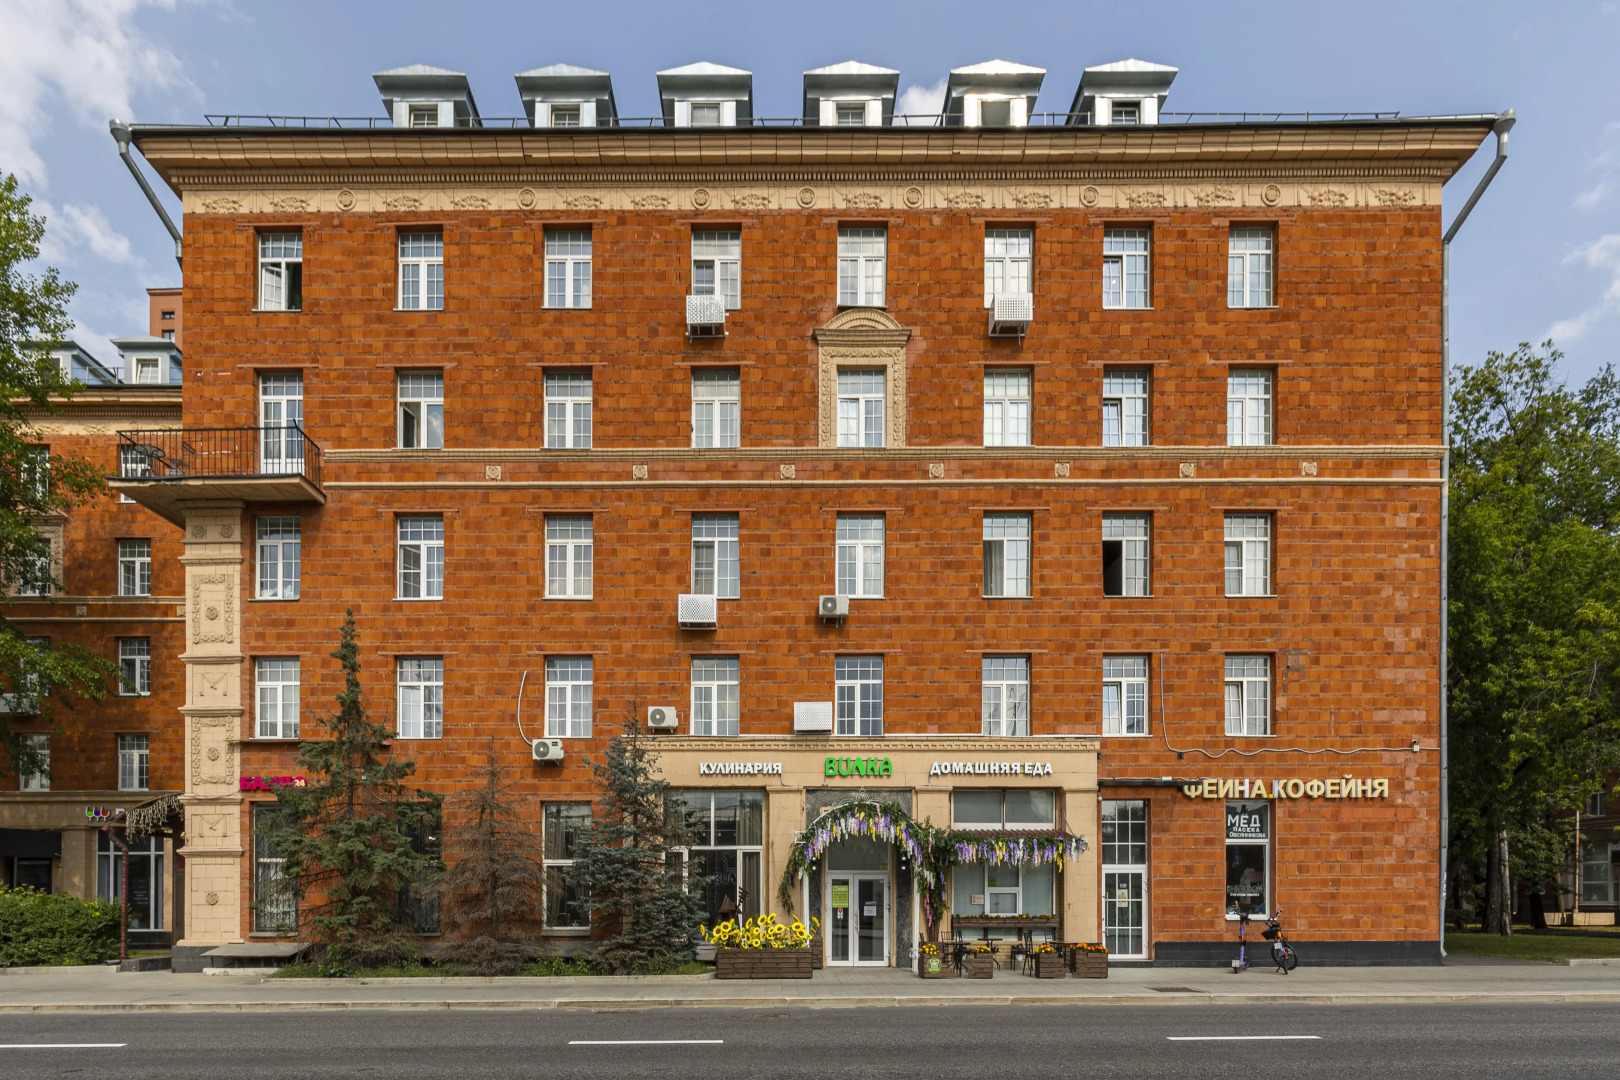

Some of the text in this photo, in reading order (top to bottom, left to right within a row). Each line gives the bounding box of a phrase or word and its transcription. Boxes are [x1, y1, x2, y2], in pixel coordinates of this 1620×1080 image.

[699, 762, 782, 775] КУЛИНАРИЯ
[929, 761, 1053, 776] ДОМАШНЯЯ ЕДА
[1227, 813, 1261, 827] МЁД
